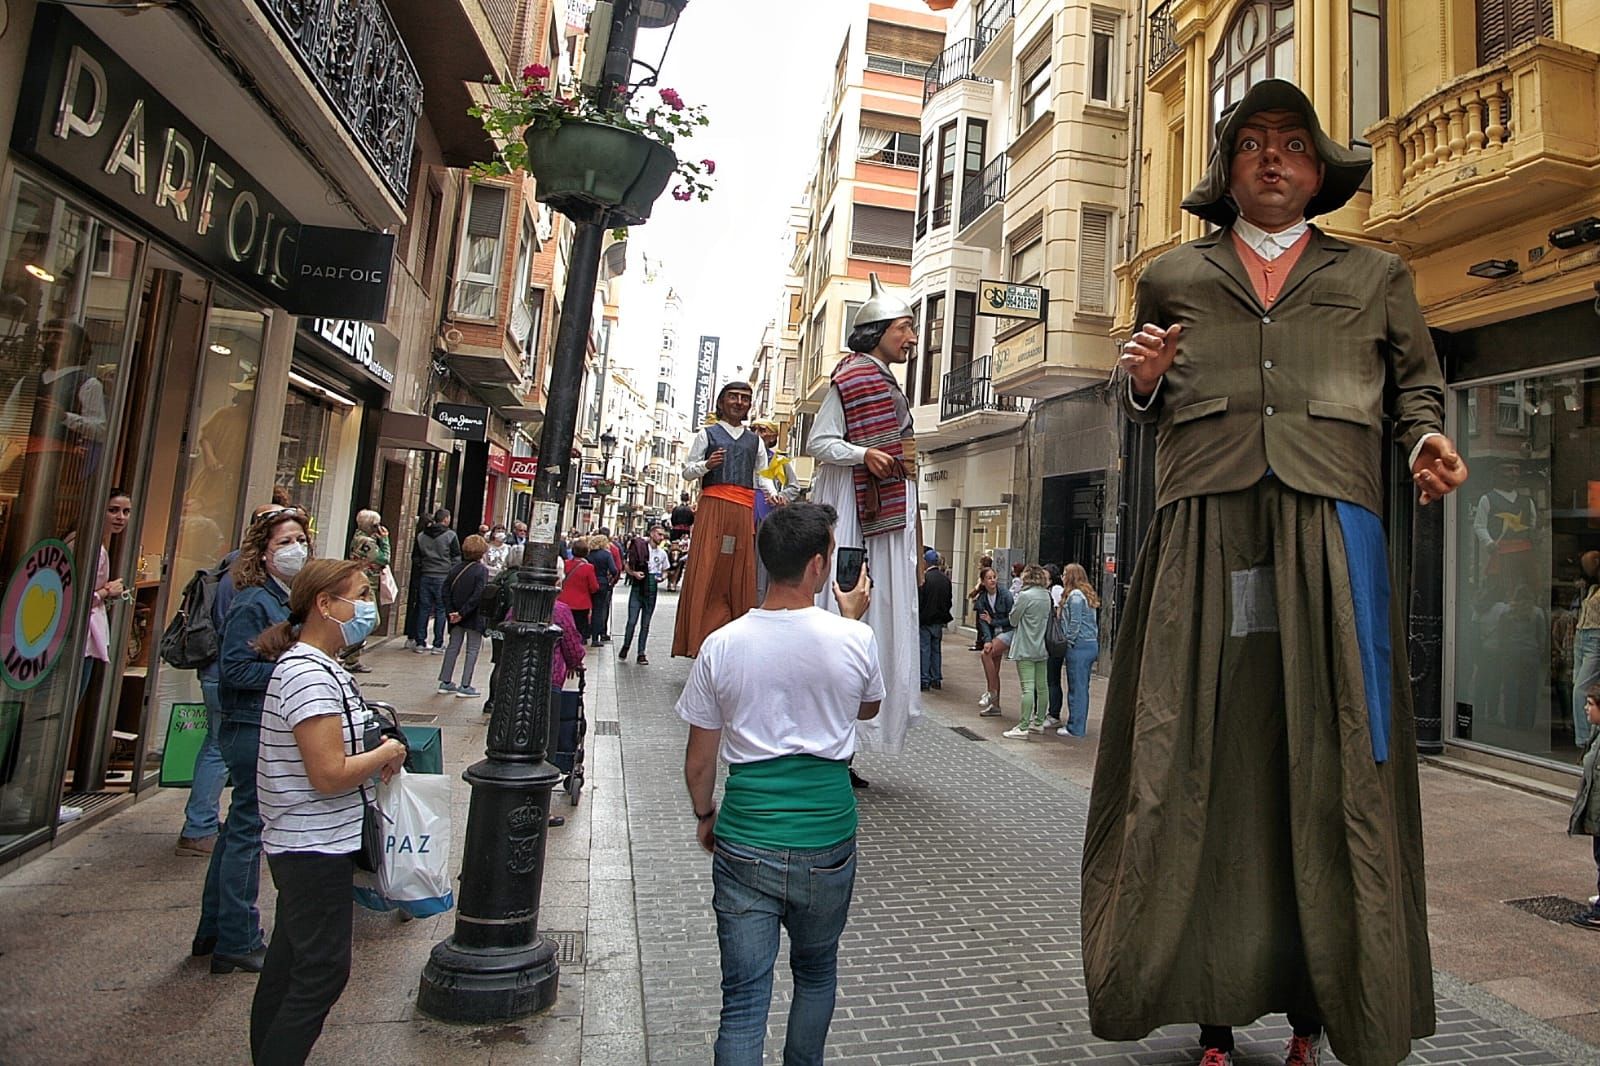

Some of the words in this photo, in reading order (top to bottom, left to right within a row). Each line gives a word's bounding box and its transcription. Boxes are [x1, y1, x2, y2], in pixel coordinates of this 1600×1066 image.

[54, 45, 297, 290] PARFOIS
[301, 264, 383, 283] PARFOIS
[26, 546, 72, 593] SUPER
[385, 834, 431, 853] PAZ
